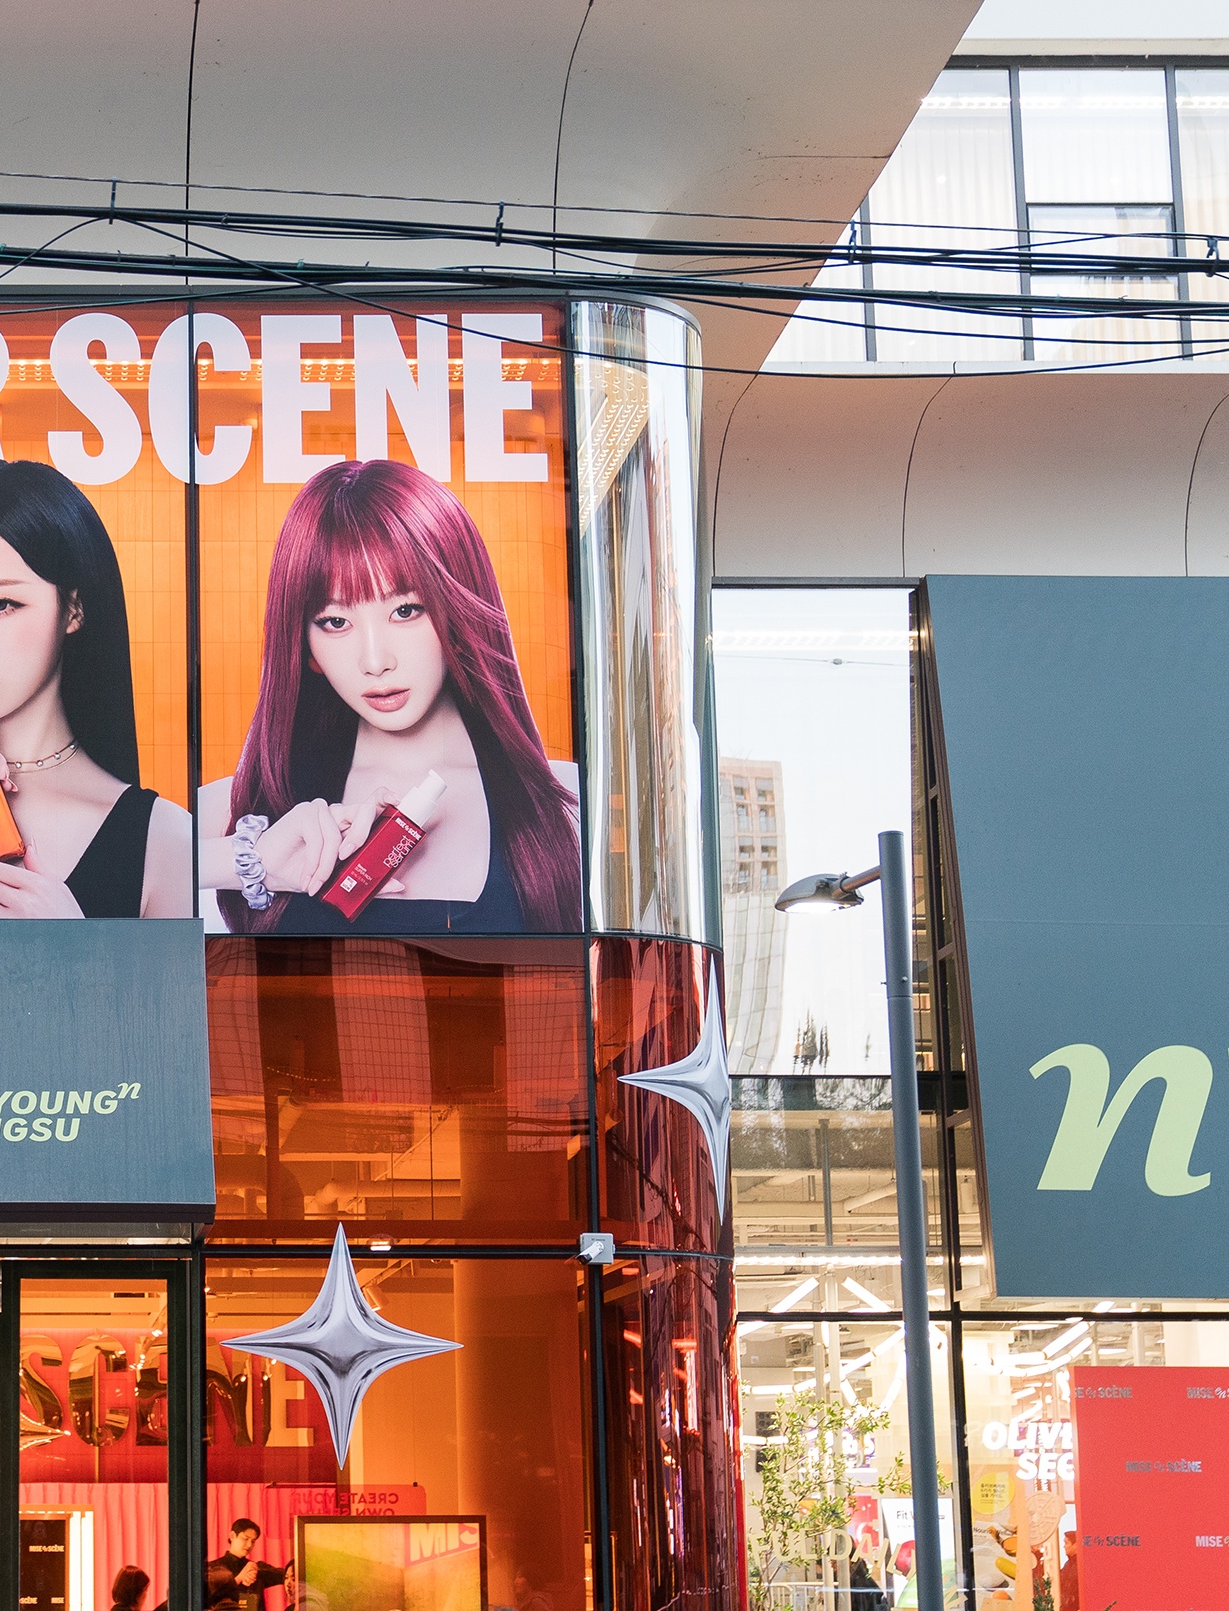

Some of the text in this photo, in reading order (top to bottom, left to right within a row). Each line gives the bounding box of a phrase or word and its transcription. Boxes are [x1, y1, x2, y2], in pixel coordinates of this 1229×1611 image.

[47, 312, 549, 485] SCENE
[383, 835, 410, 868] perfect
[390, 838, 416, 868] serum
[1097, 1385, 1133, 1398] SCÈNE
[1187, 1387, 1214, 1399] MISE
[1126, 1461, 1152, 1472] MISE
[1166, 1458, 1202, 1472] SCÈNE
[896, 1510, 908, 1520] Fit
[1106, 1533, 1141, 1547] SCÈNE
[1195, 1536, 1223, 1547] MISE
